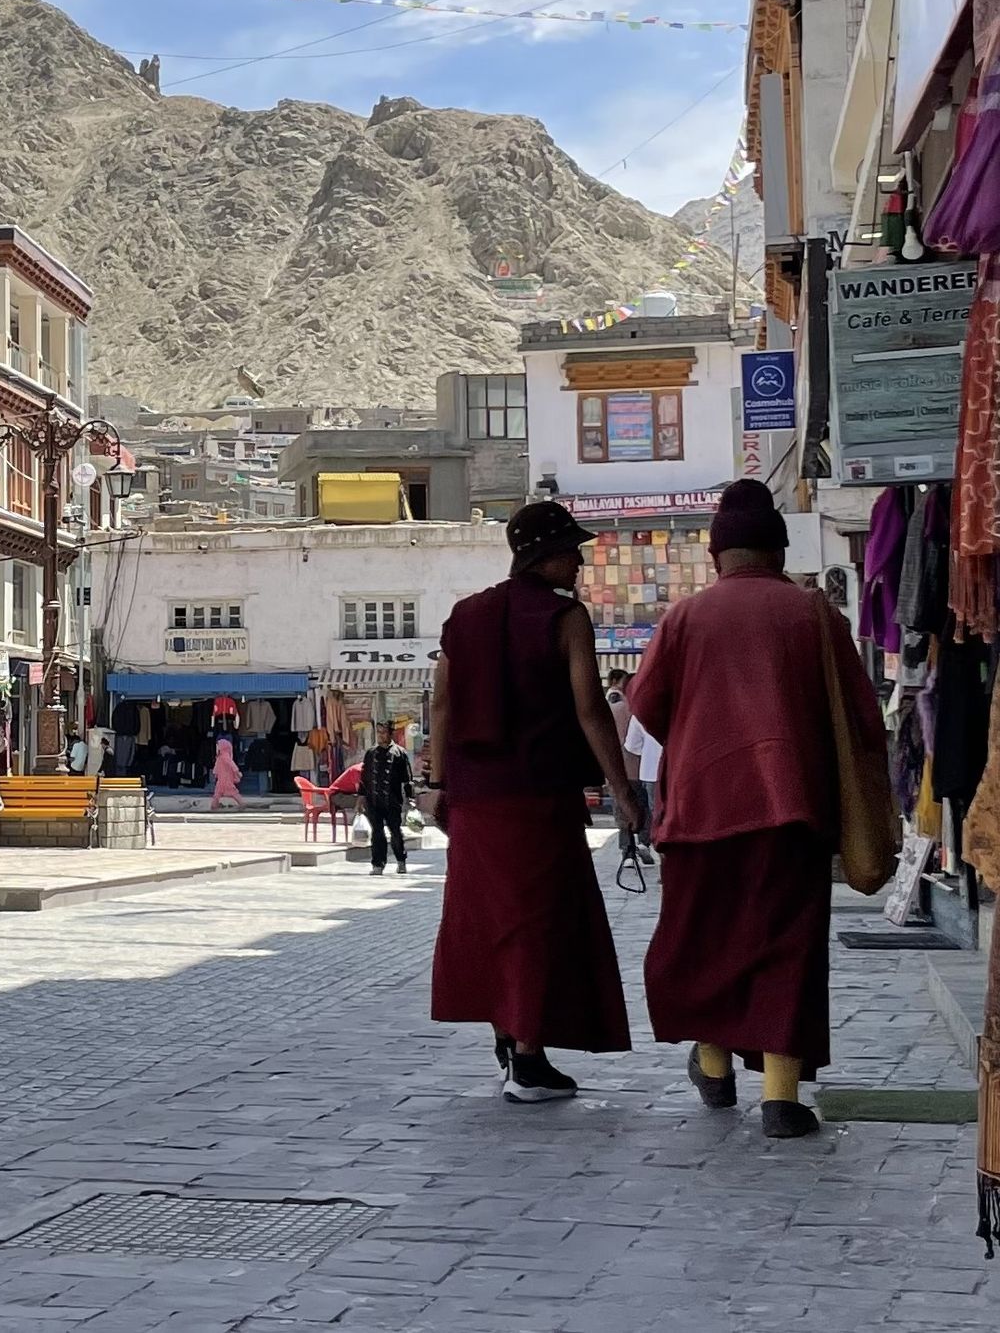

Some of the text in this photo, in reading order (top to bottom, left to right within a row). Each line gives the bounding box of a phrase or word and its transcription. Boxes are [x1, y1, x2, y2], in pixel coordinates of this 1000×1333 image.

[899, 310, 913, 325] &
[624, 495, 671, 508] PASHMINA
[339, 650, 416, 663] The
